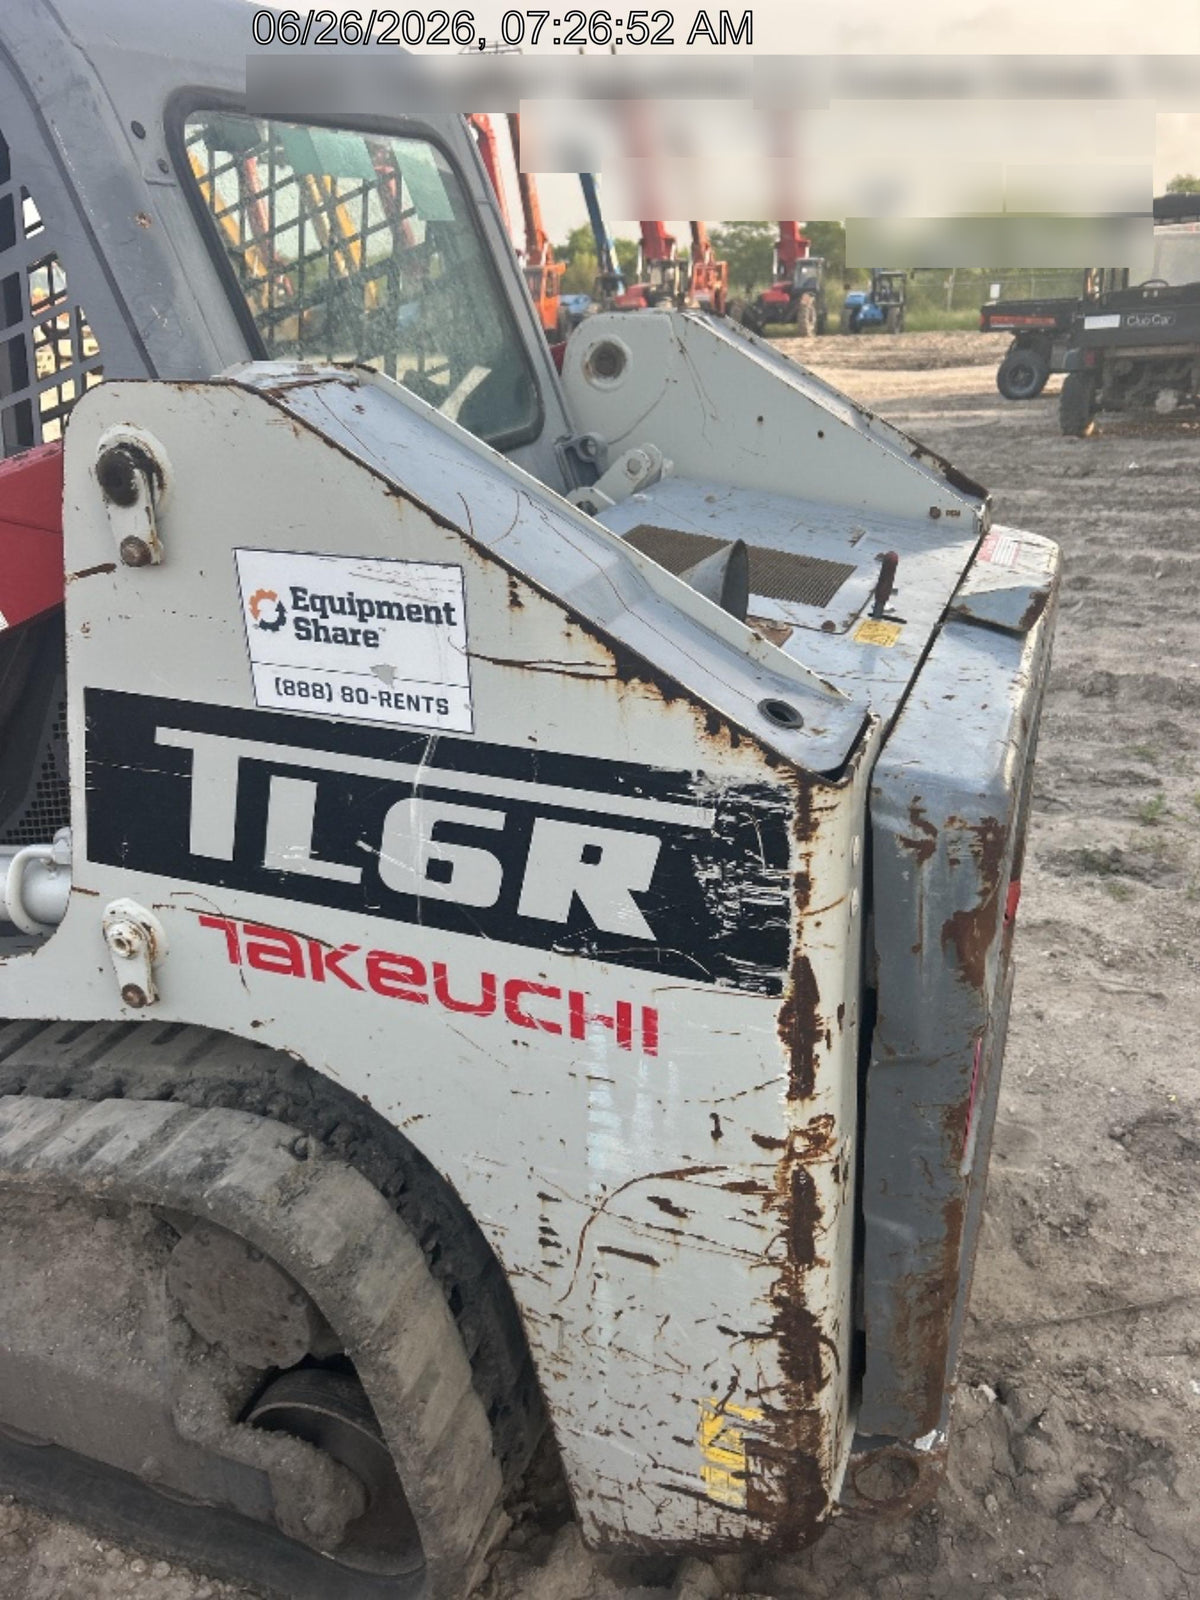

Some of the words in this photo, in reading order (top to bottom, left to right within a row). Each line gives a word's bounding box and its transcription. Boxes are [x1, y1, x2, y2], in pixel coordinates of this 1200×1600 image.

[289, 586, 458, 626] Equipment
[274, 677, 334, 702] (888)
[340, 686, 450, 715] 80-RENTS
[154, 726, 717, 941] TL6R
